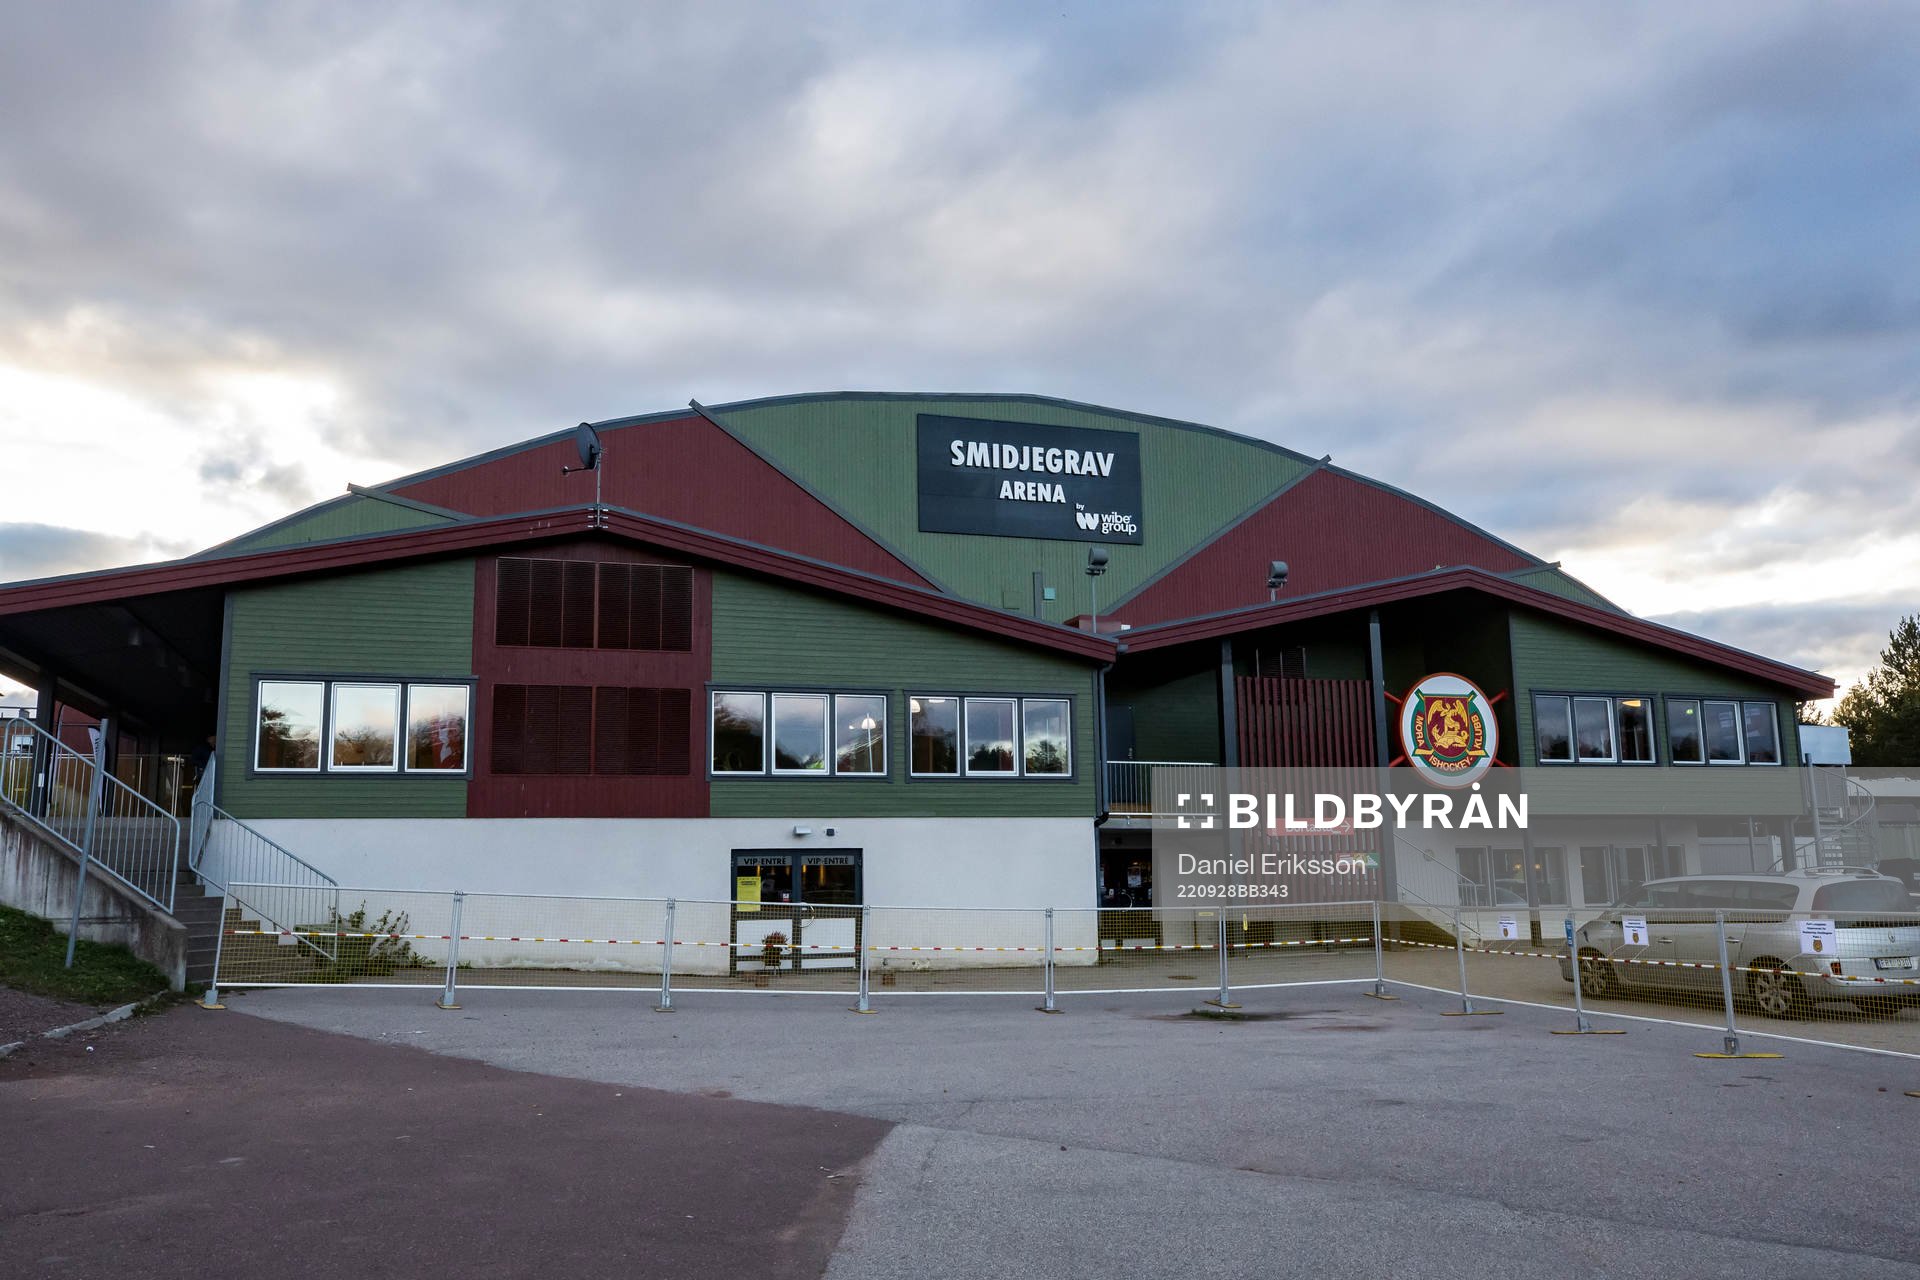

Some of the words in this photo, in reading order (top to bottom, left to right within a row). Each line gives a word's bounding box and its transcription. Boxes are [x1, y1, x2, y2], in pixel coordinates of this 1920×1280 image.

[950, 439, 1115, 477] SMIDJEGRAV
[999, 480, 1066, 504] ARENA
[1076, 503, 1085, 511] by
[1101, 511, 1131, 524] wibe
[1101, 522, 1137, 535] group
[1415, 715, 1424, 747] MORA
[1470, 714, 1483, 749] KLUBB
